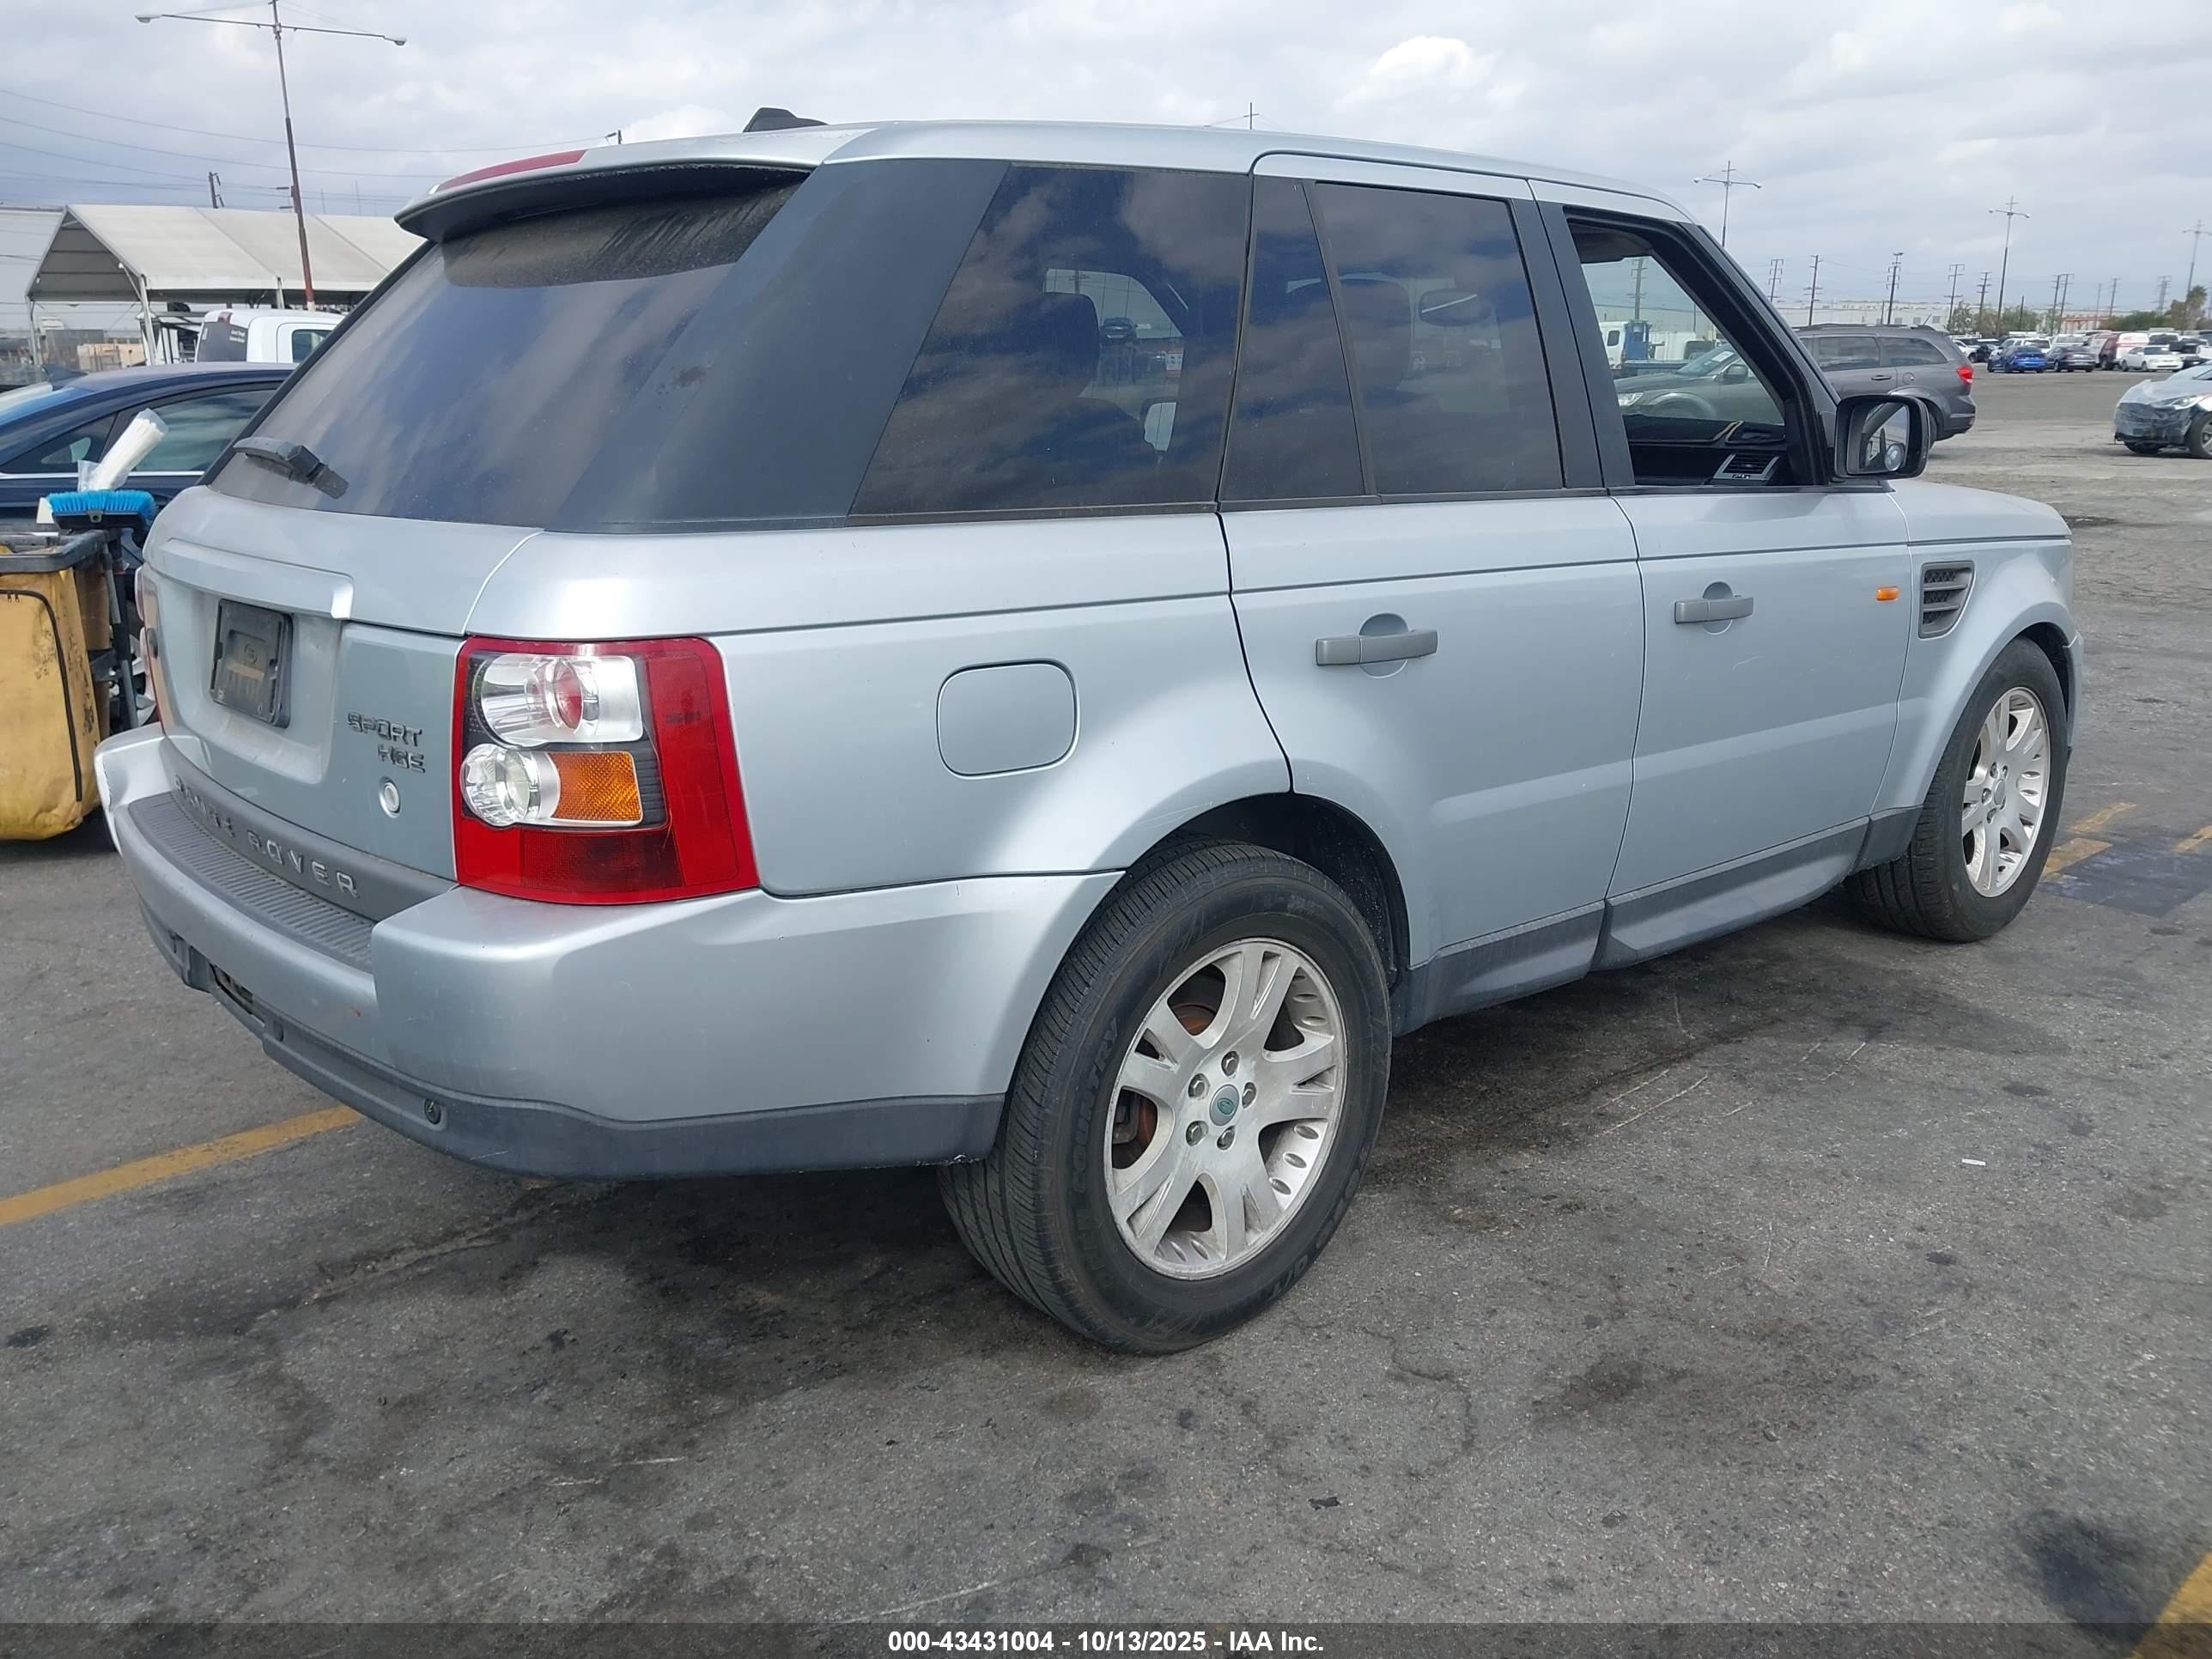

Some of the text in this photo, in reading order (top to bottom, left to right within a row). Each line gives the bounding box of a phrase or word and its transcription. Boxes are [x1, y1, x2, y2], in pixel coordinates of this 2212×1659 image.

[347, 712, 423, 747] SPORT
[247, 830, 361, 900] ROVER
[1073, 1018, 1119, 1194] COUNTRY
